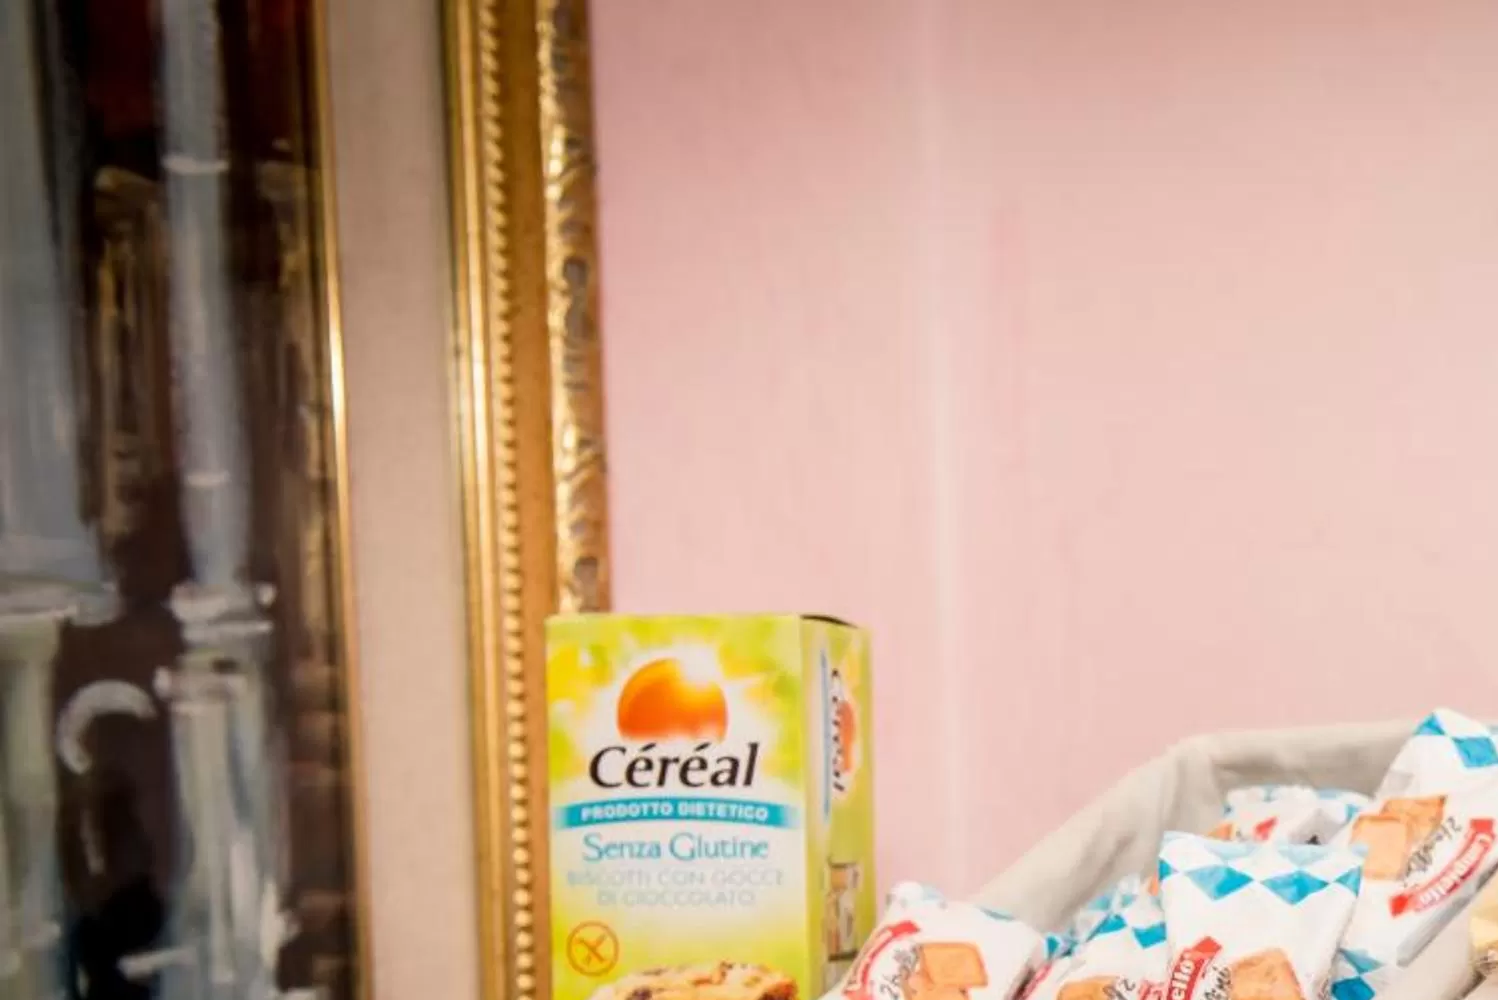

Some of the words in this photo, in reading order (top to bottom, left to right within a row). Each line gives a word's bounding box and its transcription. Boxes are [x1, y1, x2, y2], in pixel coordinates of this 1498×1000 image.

[589, 742, 760, 788] Céréal
[581, 803, 672, 821] PRODOTTO
[677, 803, 768, 820] DIETETICO
[582, 832, 661, 862] Senza
[669, 832, 769, 861] Glutine
